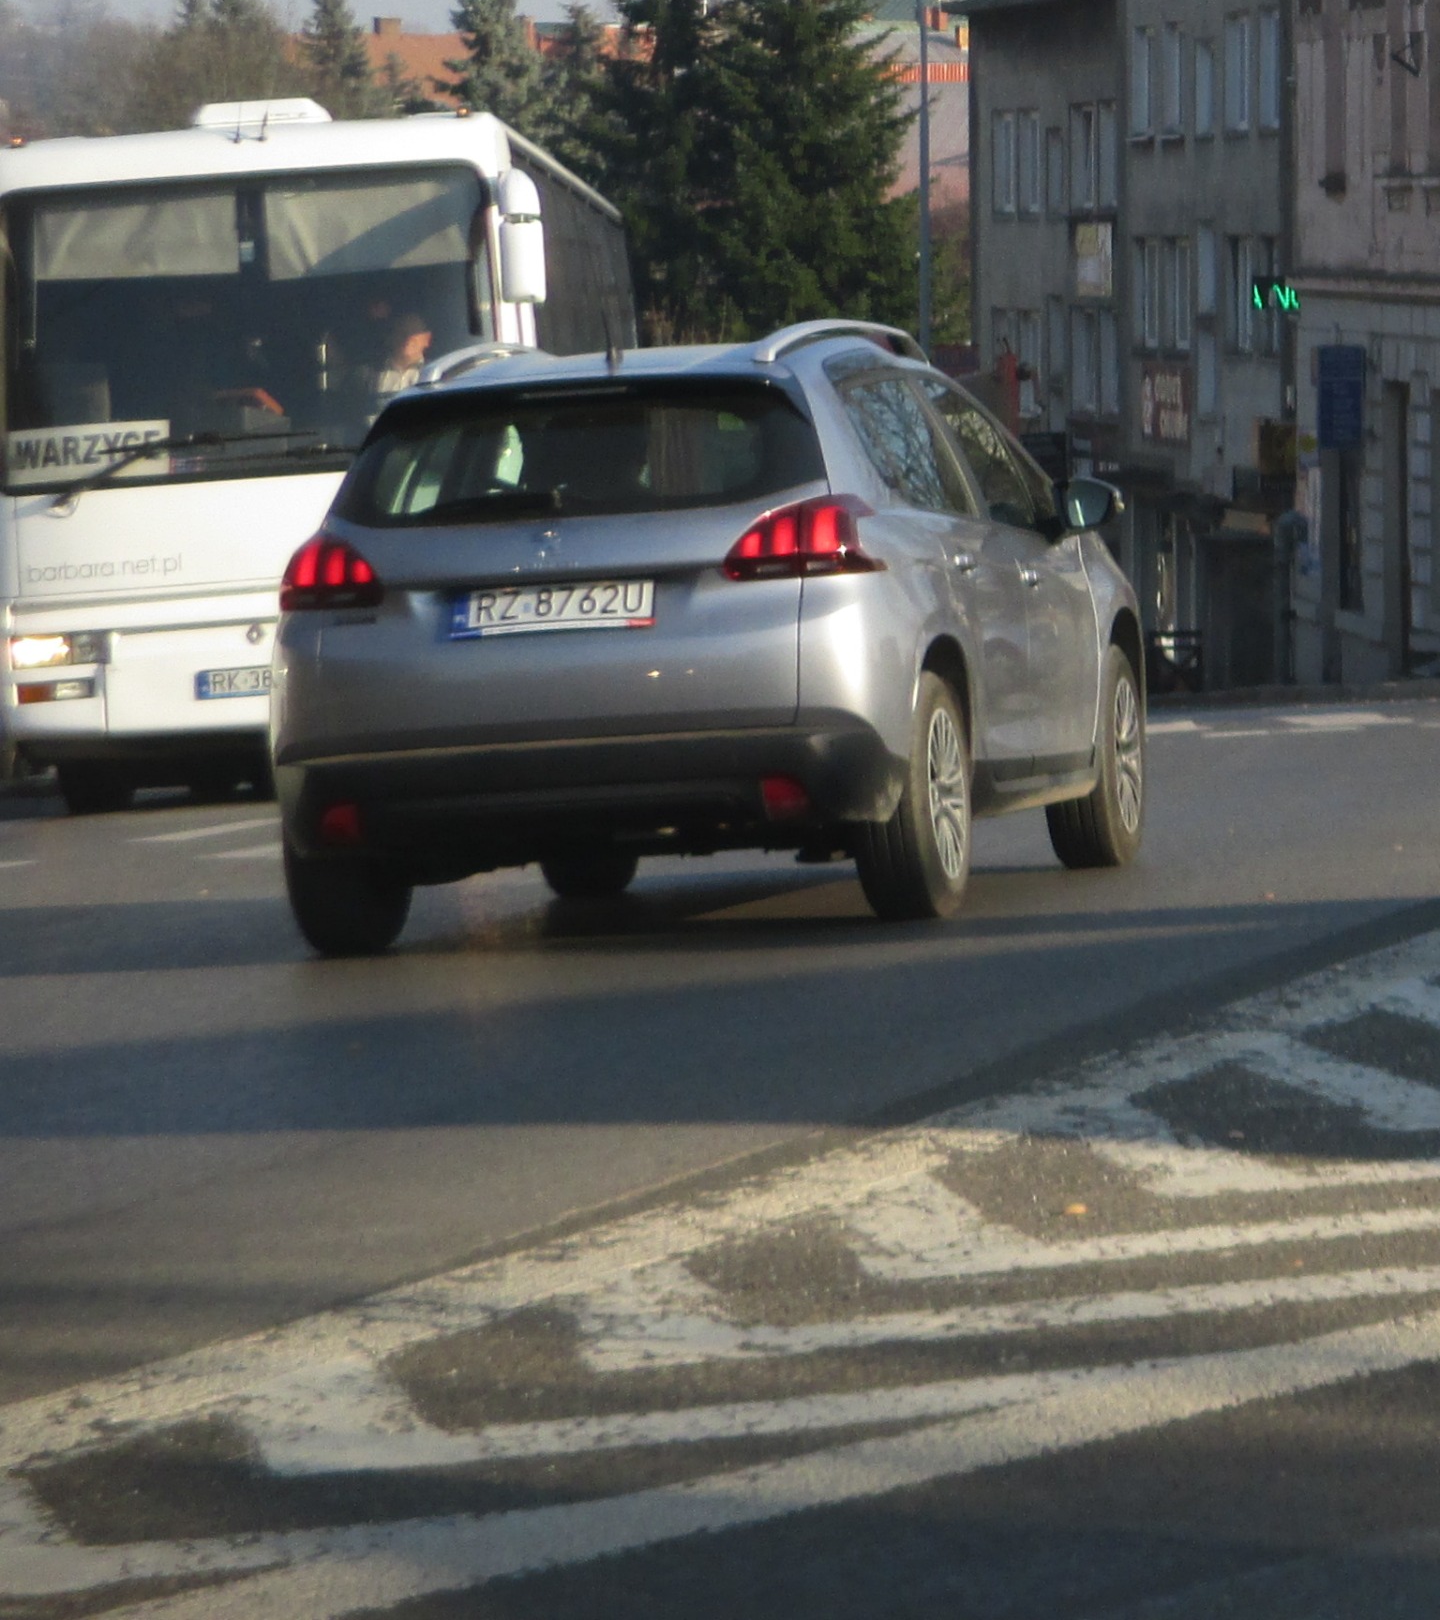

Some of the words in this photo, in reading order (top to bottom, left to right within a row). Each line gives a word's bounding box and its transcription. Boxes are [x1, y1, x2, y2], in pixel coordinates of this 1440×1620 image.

[27, 553, 183, 582] barbara.net.pl
[477, 591, 520, 624] RZ
[535, 581, 645, 618] 8762U
[211, 671, 241, 693] RK
